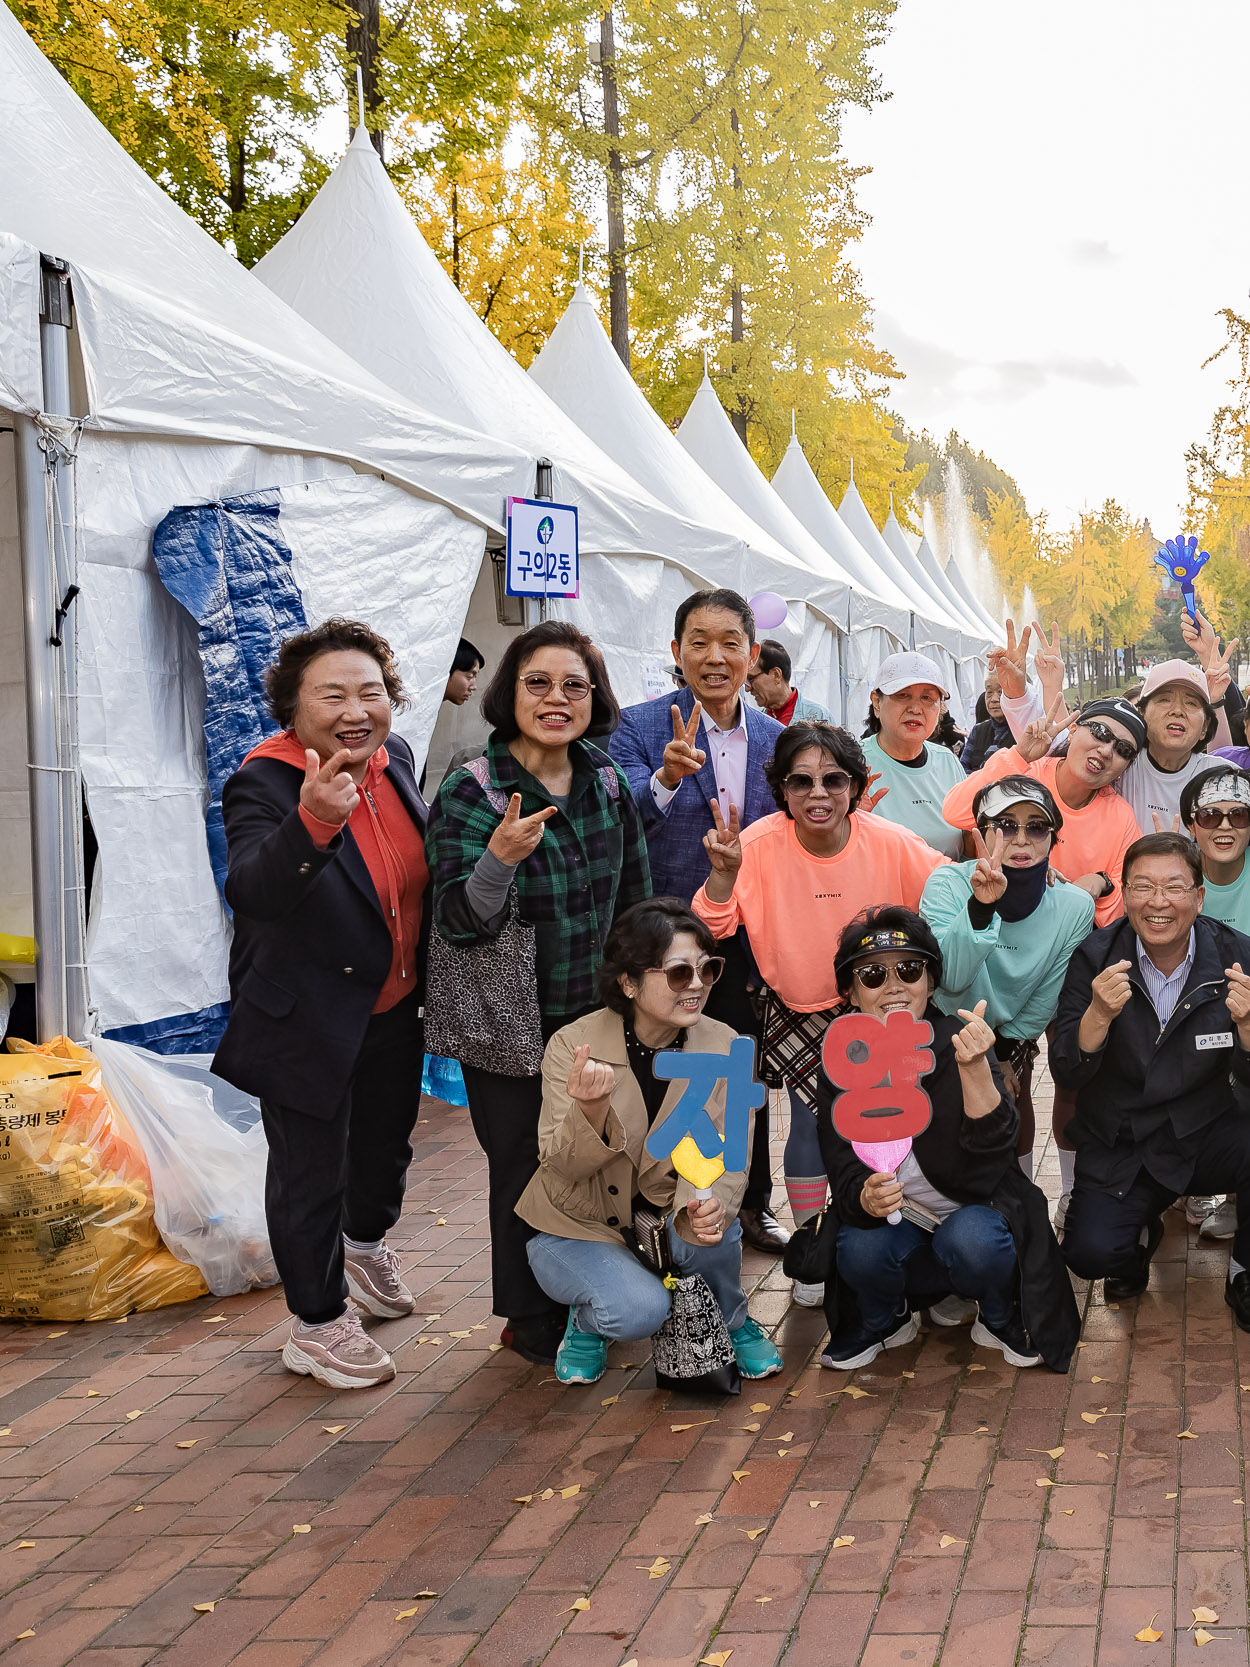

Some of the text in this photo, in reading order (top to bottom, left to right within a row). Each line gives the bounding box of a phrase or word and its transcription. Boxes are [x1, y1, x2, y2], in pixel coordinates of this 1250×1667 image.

[517, 550, 571, 586] 구의2동
[646, 1036, 766, 1172] 자
[822, 1009, 936, 1144] 양
